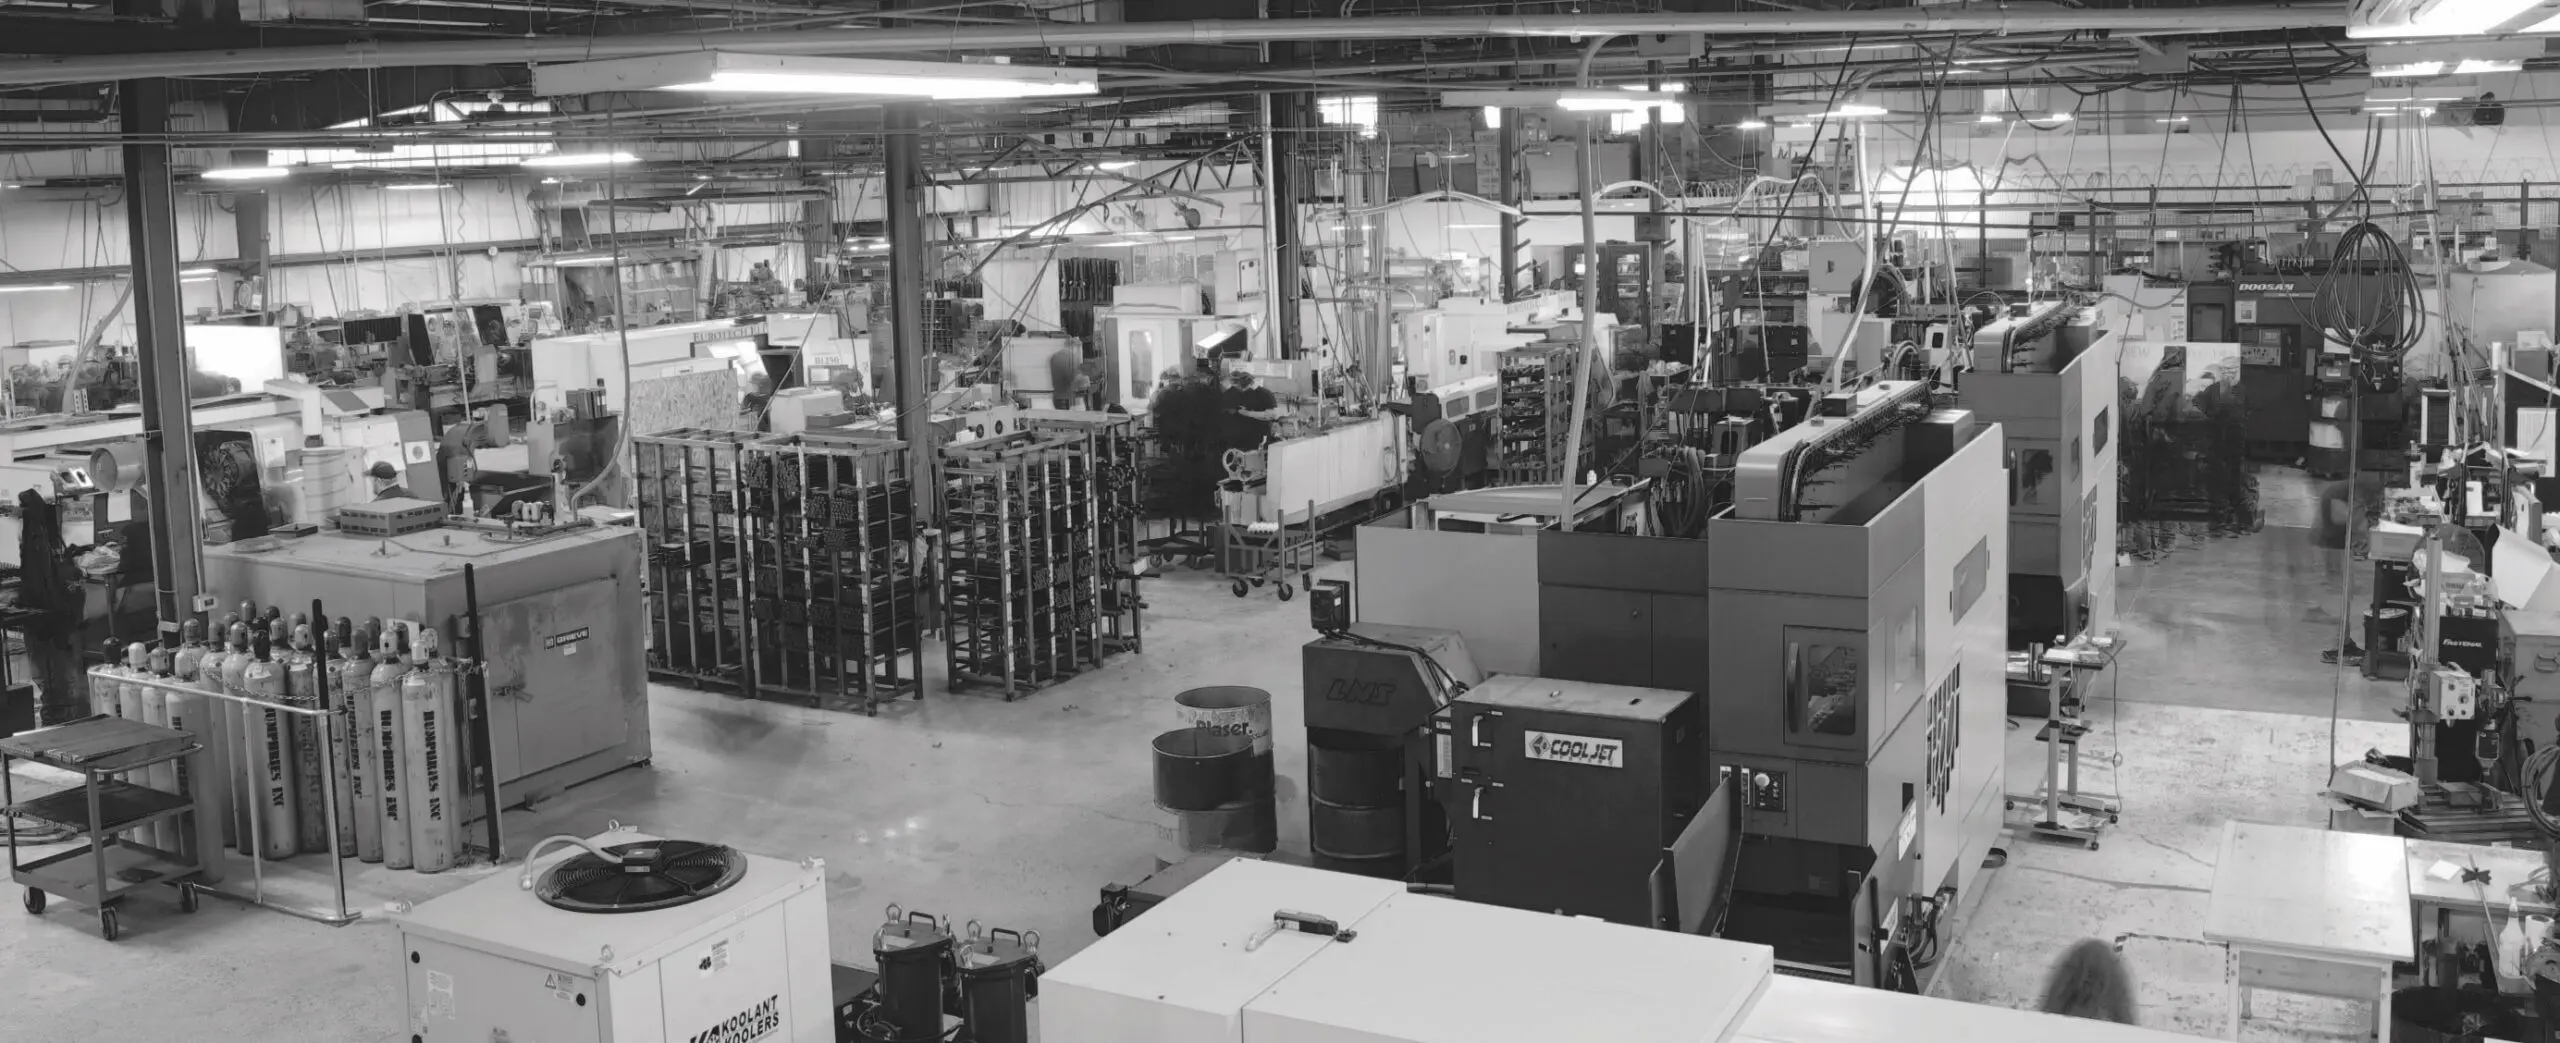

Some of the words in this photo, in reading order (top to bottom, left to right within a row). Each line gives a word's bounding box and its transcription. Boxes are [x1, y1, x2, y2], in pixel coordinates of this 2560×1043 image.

[2239, 283, 2295, 291] DOOSAN
[1326, 677, 1397, 707] LNS
[429, 797, 442, 821] INC
[721, 993, 779, 1037] KOOLANT
